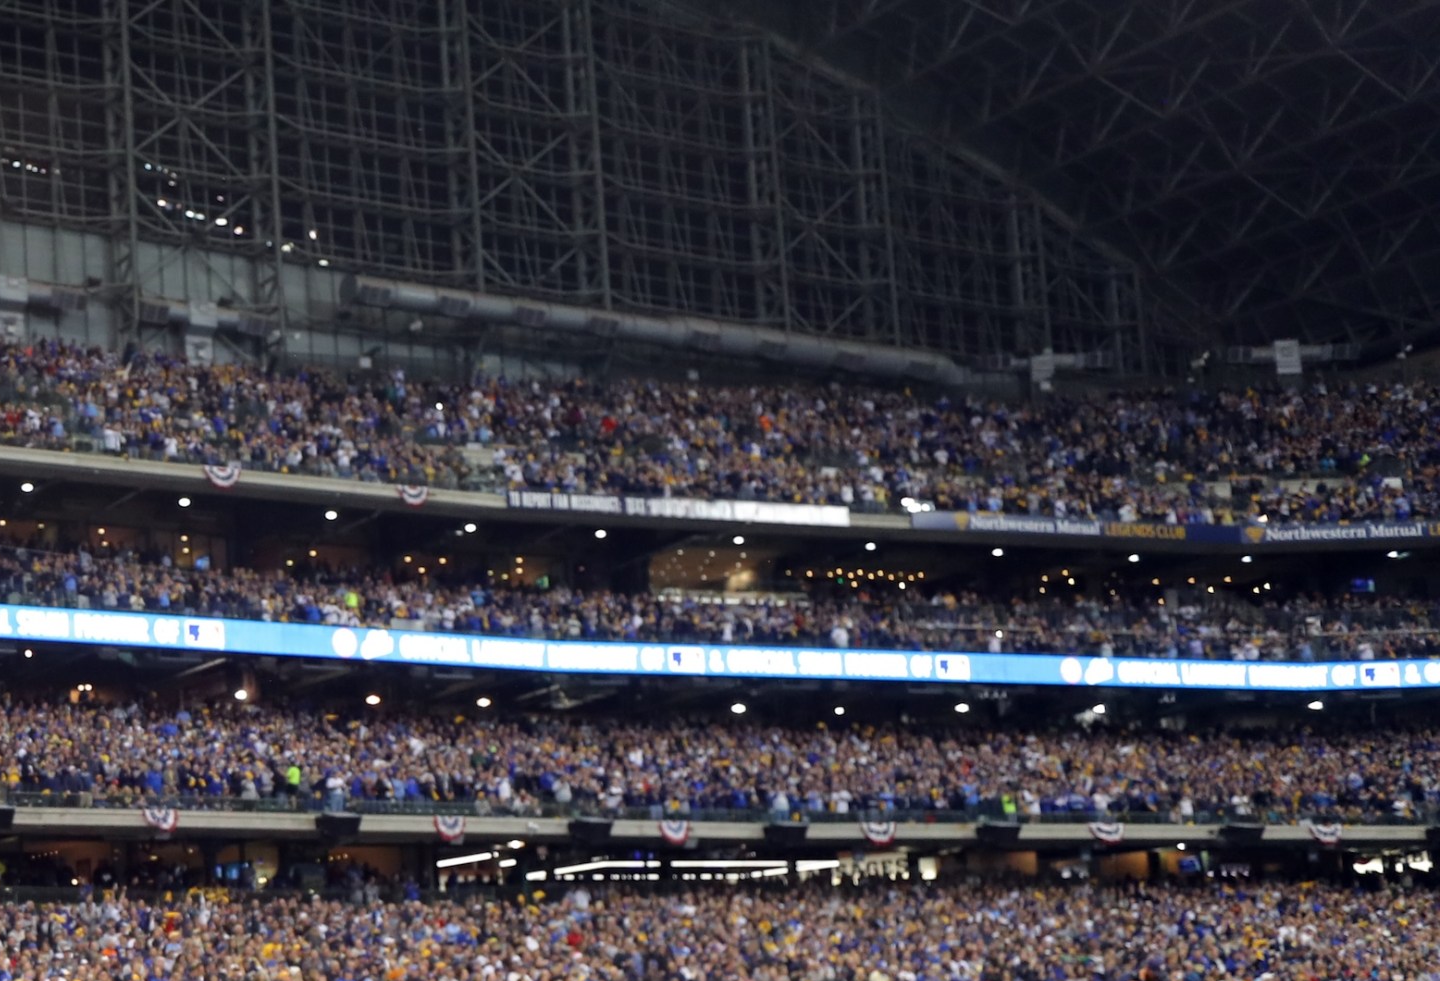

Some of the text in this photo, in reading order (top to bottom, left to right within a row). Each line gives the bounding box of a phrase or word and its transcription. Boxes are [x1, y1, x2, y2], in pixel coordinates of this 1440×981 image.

[970, 517, 1056, 534] Northwestern
[1057, 518, 1102, 536] Mutual
[1265, 523, 1367, 541] Northwestern
[1368, 521, 1423, 538] Mutual
